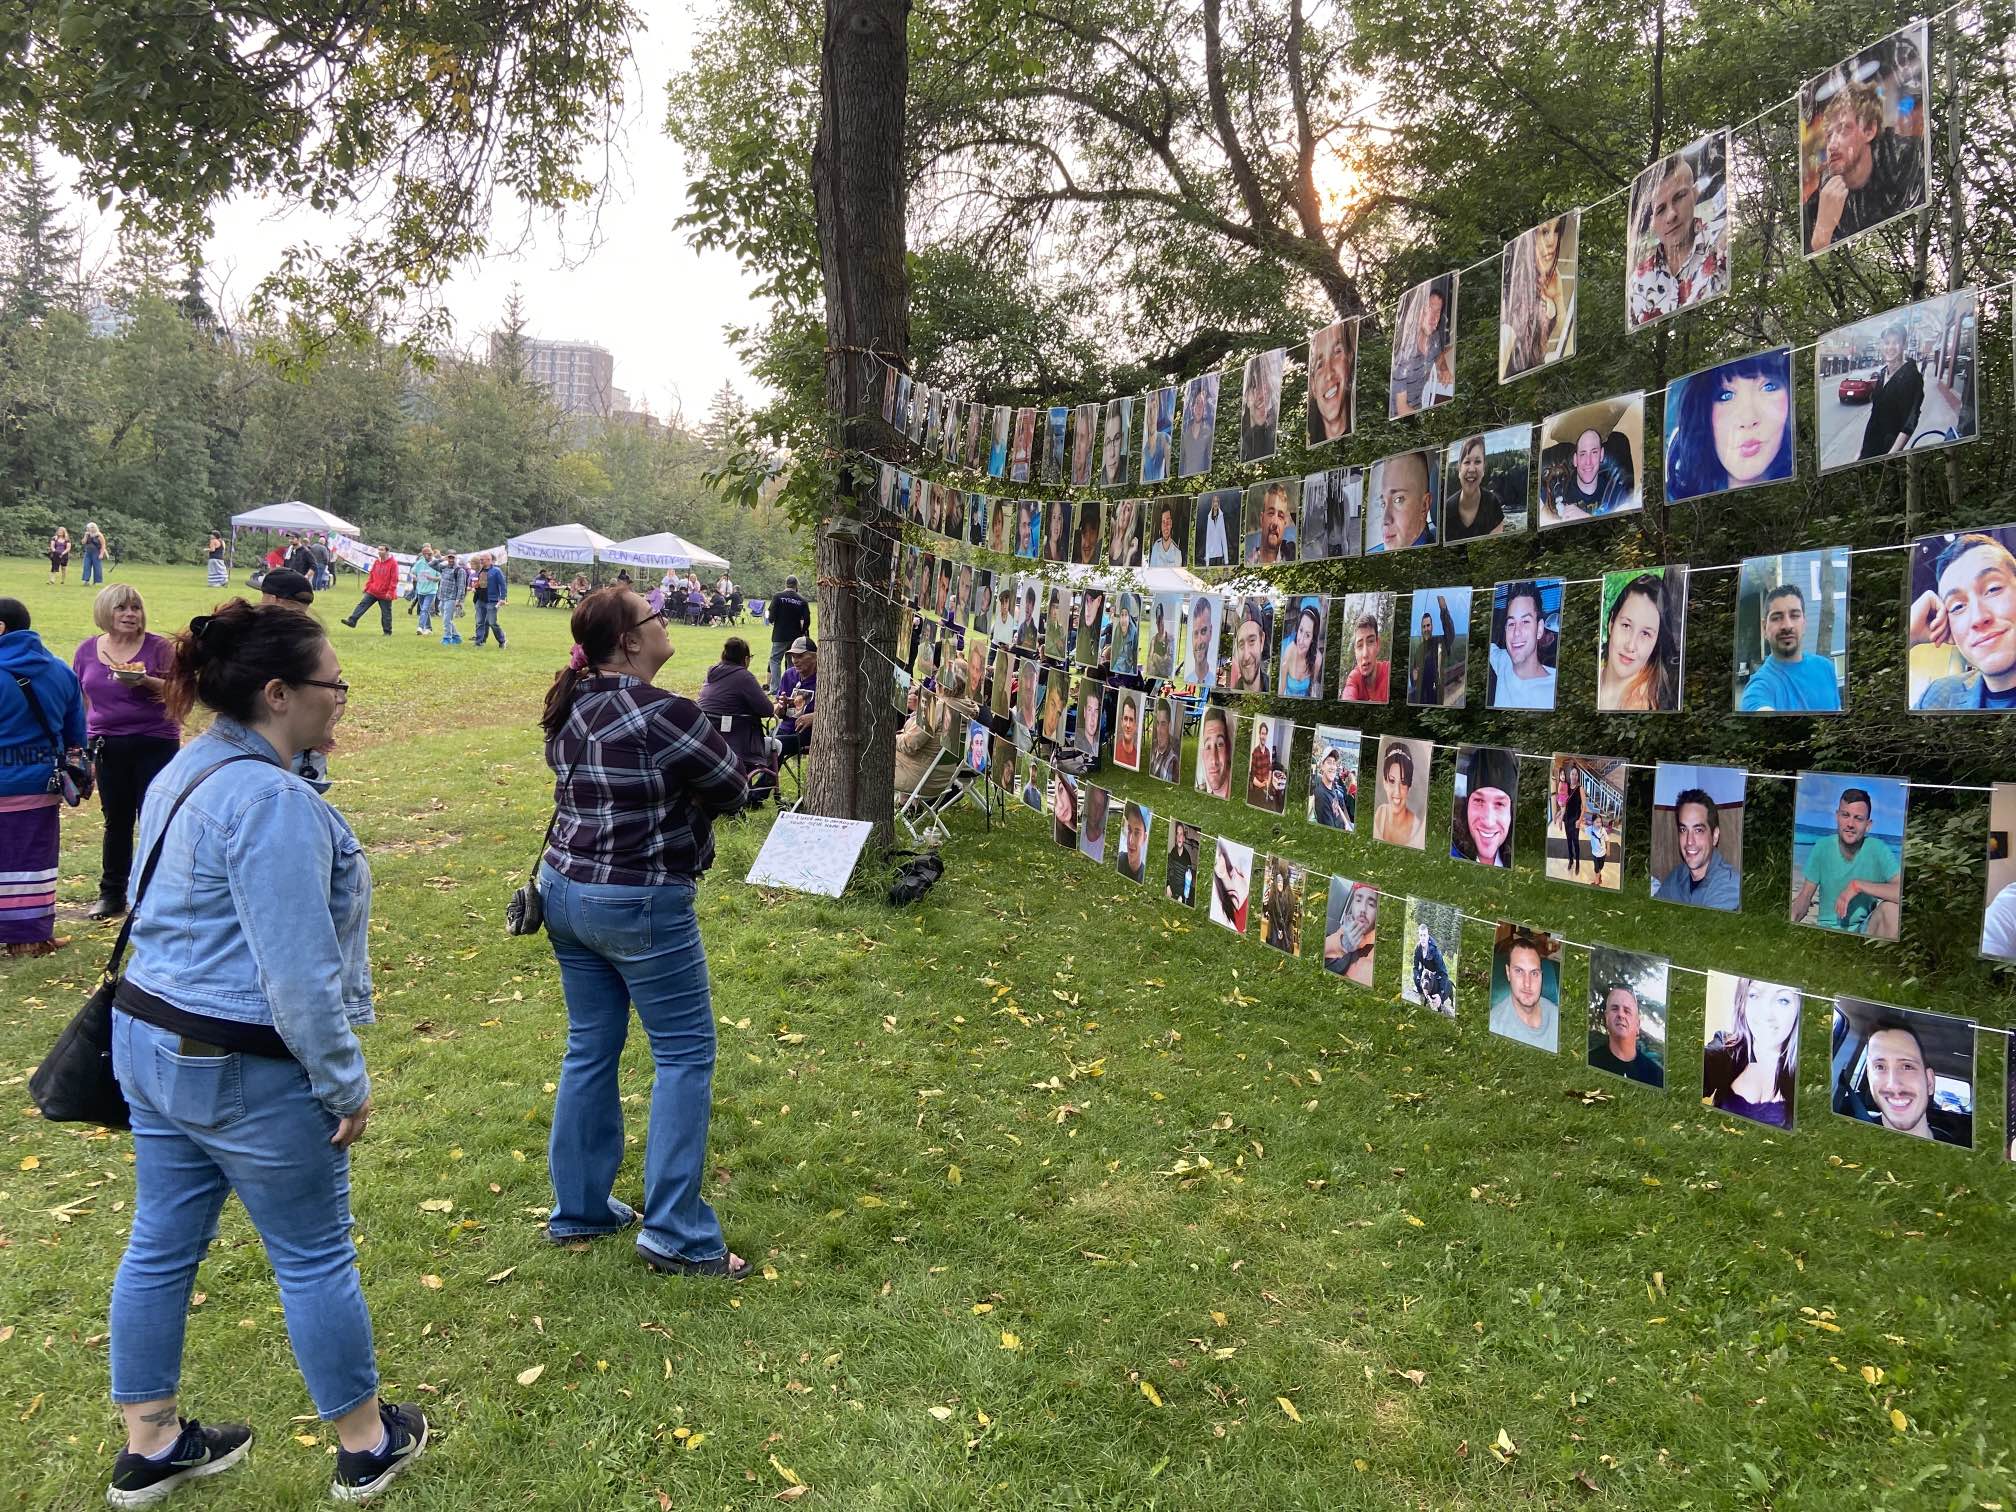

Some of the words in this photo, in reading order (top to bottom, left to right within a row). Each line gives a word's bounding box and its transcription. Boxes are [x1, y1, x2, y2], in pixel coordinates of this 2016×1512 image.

[517, 543, 536, 557] FUN
[539, 547, 583, 561] ACTIVITY
[633, 553, 675, 565] ACTIVITY
